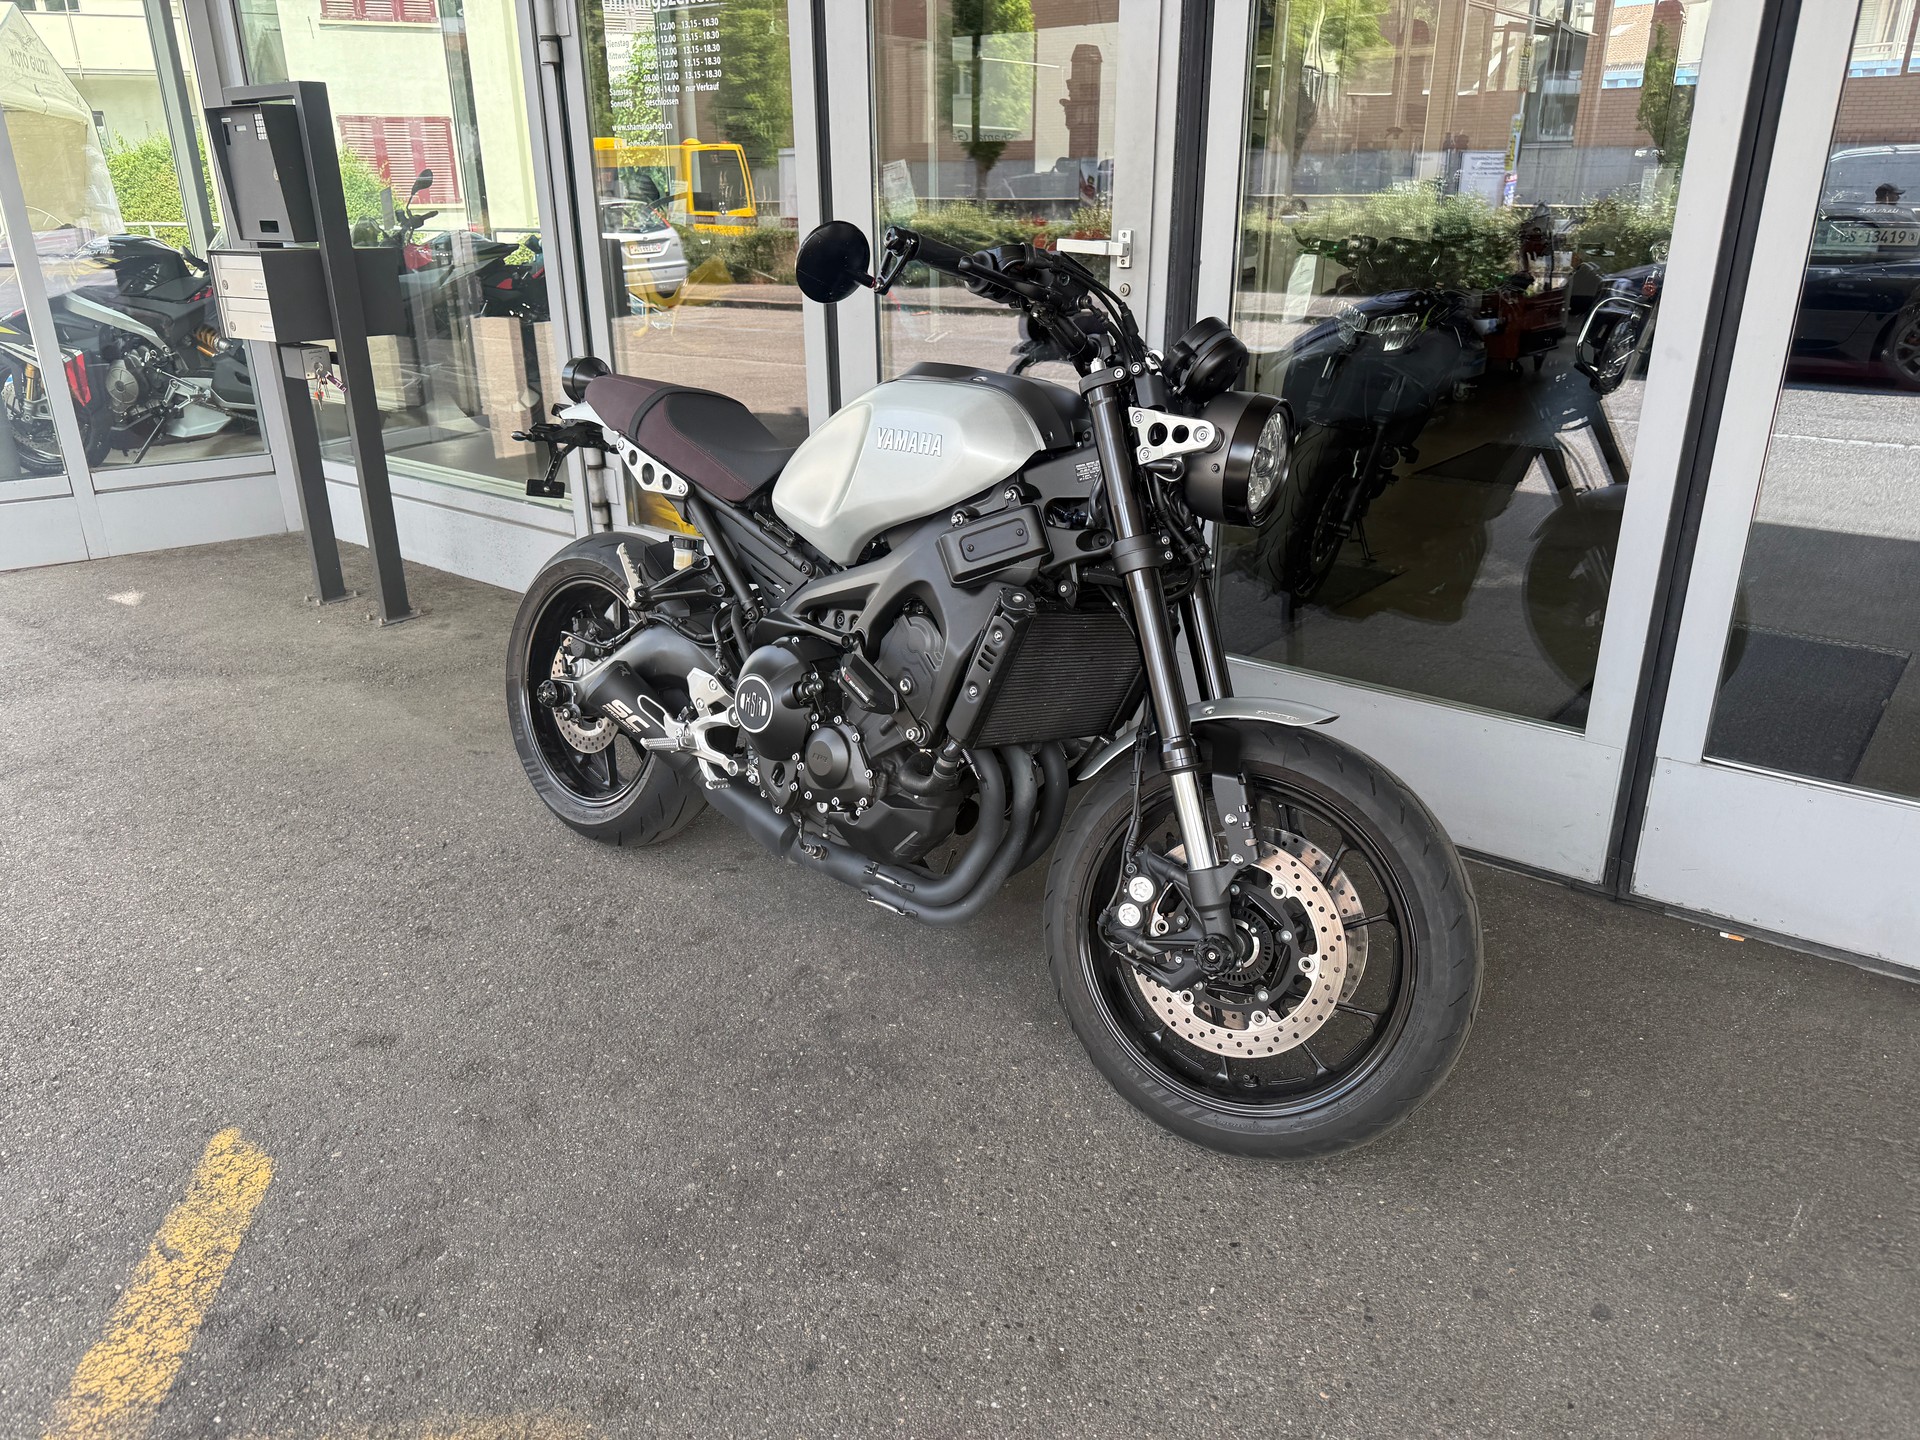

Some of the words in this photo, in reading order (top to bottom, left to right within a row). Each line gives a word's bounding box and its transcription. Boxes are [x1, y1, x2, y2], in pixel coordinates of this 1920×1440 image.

[660, 22, 676, 30] 12.00
[681, 20, 698, 29] 13.15
[702, 18, 718, 26] 18.30
[660, 34, 676, 44] 12.00
[682, 32, 698, 42] 13.15
[702, 30, 720, 40] 18.30
[661, 47, 678, 56] 12.00
[683, 45, 699, 54] 13.15
[704, 44, 720, 52] 18.30
[8, 48, 29, 70] MOTO
[662, 60, 678, 68] 12.00
[684, 58, 700, 67] 13.15
[704, 56, 721, 66] 18.30
[663, 72, 679, 80] 12.00
[685, 70, 700, 80] 13.15
[705, 70, 722, 78] 18.30
[610, 88, 633, 97] Samstag
[644, 86, 660, 94] 09.00
[664, 84, 680, 94] 14.00
[696, 82, 720, 92] Verkauf
[610, 99, 633, 108] Sonntag
[645, 98, 679, 108] geschlossen
[1864, 230, 1906, 243] 13419
[877, 426, 943, 458] YAMAHA
[602, 700, 650, 732] SC
